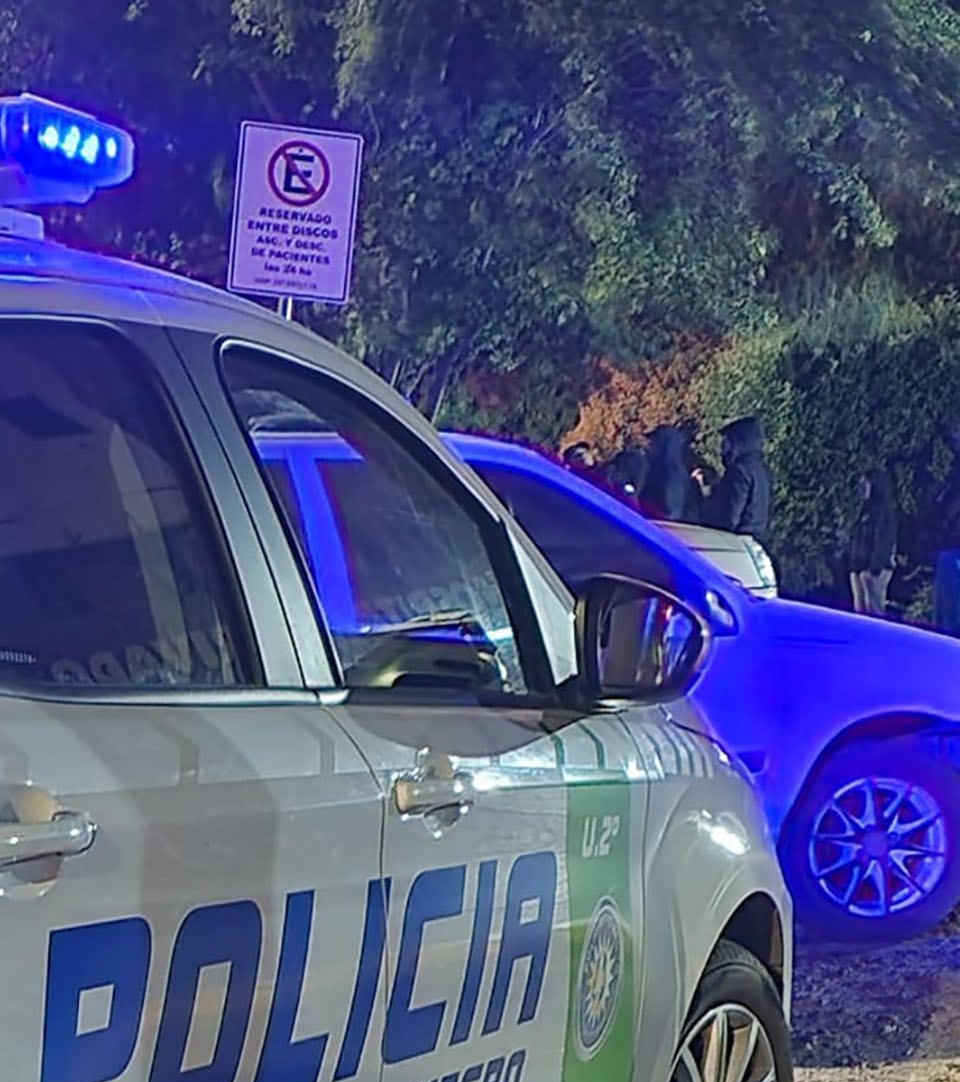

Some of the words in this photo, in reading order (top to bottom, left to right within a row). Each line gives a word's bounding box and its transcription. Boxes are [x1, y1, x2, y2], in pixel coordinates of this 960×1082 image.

[259, 207, 332, 225] RESERVADO
[247, 220, 289, 234] ENTRE
[292, 225, 338, 239] DISCOS
[285, 238, 294, 248] Y
[251, 247, 266, 257] DE
[269, 249, 330, 265] PACIENTES
